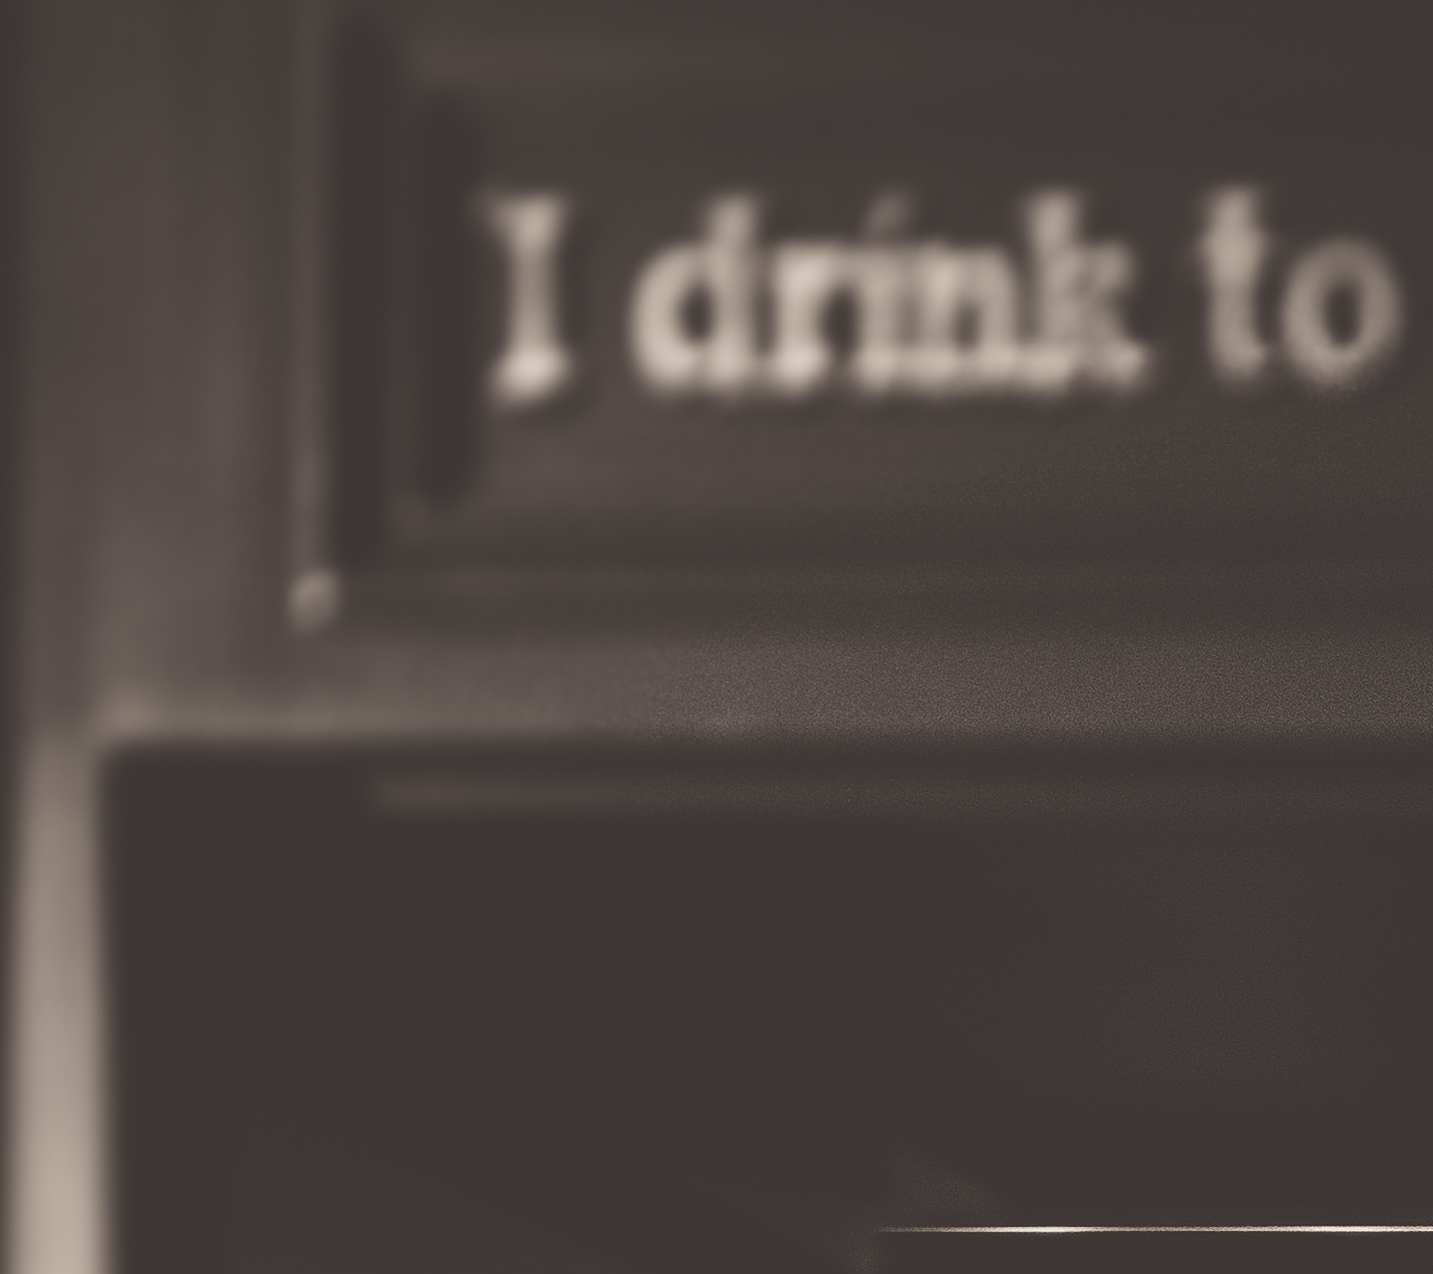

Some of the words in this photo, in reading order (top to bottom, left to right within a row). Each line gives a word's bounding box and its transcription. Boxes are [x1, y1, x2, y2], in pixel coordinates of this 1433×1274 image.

[484, 193, 578, 402] I
[630, 194, 1152, 394] drink
[1198, 189, 1403, 383] to
